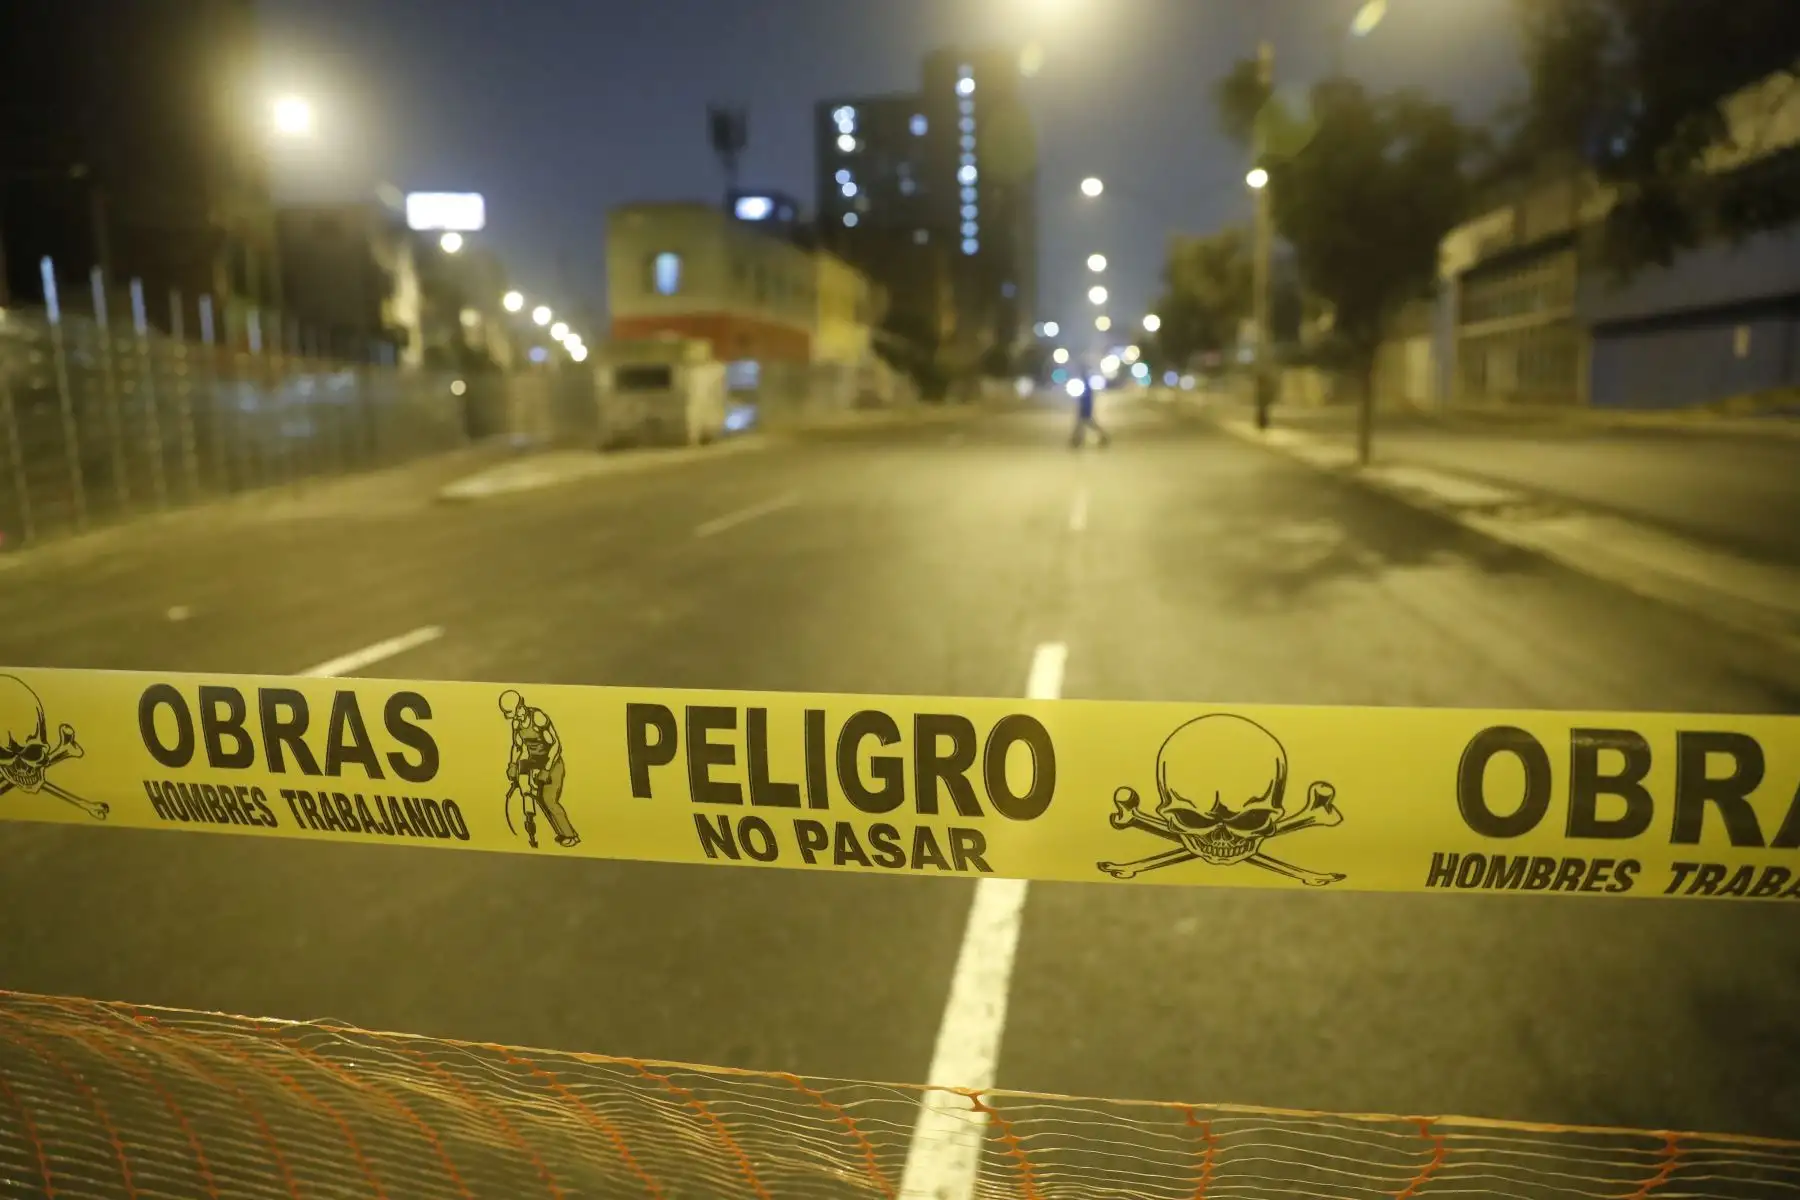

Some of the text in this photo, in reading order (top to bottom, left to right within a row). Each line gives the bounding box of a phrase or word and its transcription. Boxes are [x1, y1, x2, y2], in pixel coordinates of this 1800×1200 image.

[139, 684, 440, 783] OBRAS
[626, 703, 1056, 821] PELIGRO
[143, 781, 471, 841] HOMBRES TRABAJANDO
[693, 813, 995, 873] NO PASAR
[1425, 852, 1641, 893] HOMBRES
